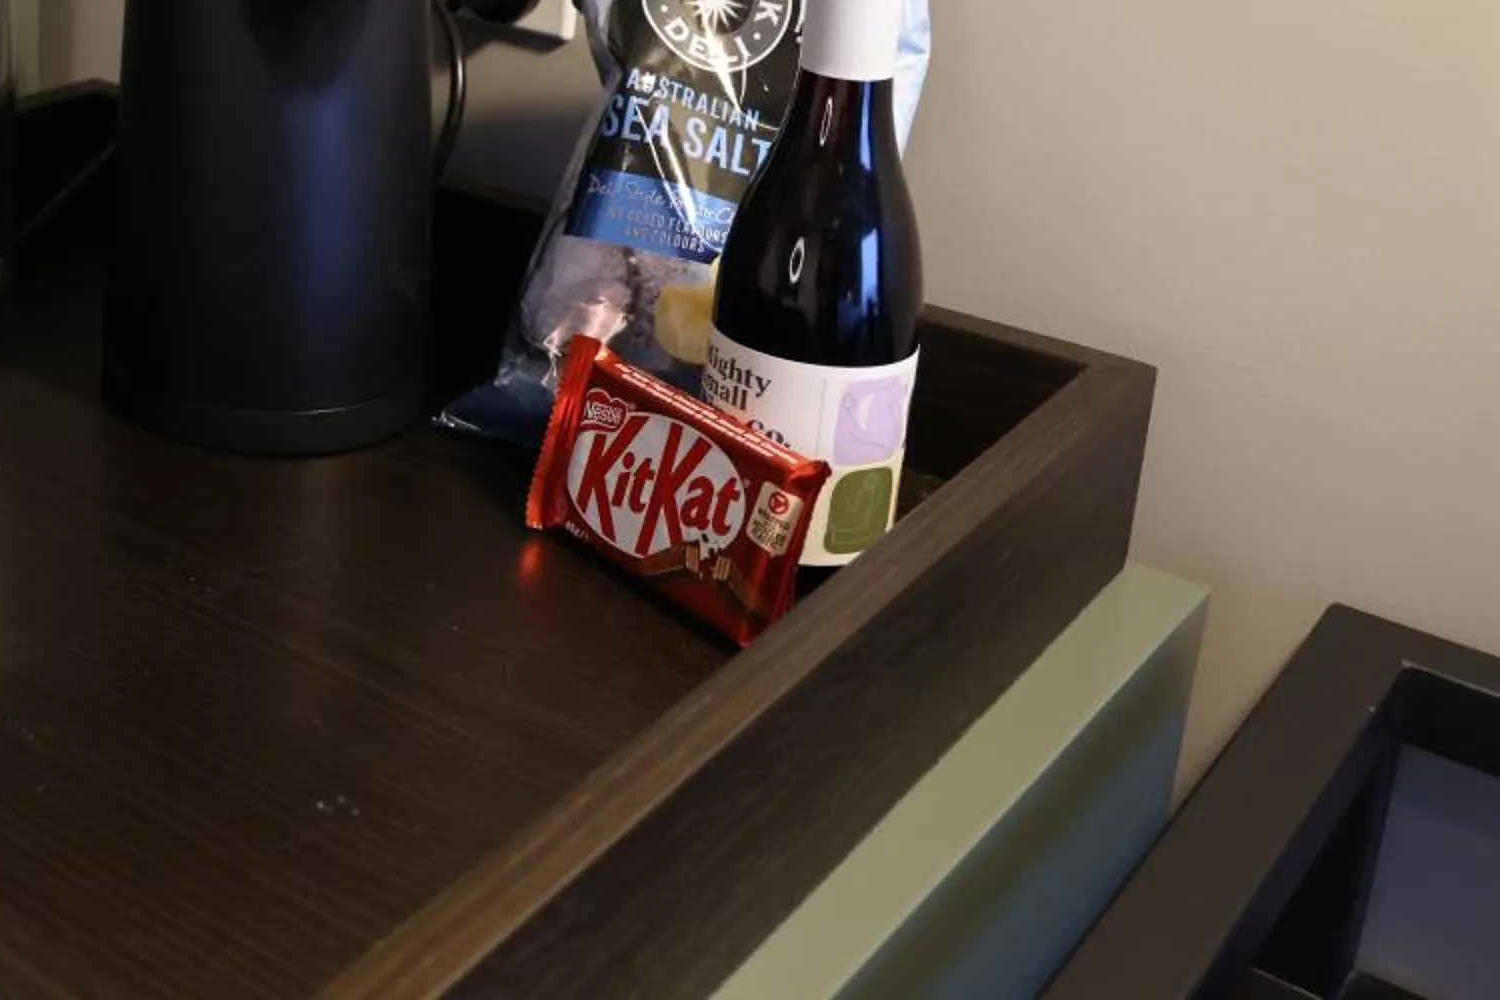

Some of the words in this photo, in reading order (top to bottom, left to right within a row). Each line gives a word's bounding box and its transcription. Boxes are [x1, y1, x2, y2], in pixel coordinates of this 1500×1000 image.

[602, 94, 669, 147] SEA
[684, 116, 772, 175] SALT
[626, 68, 759, 131] AUSTRALIAN
[703, 374, 748, 411] mall
[576, 415, 740, 555] KitKat
